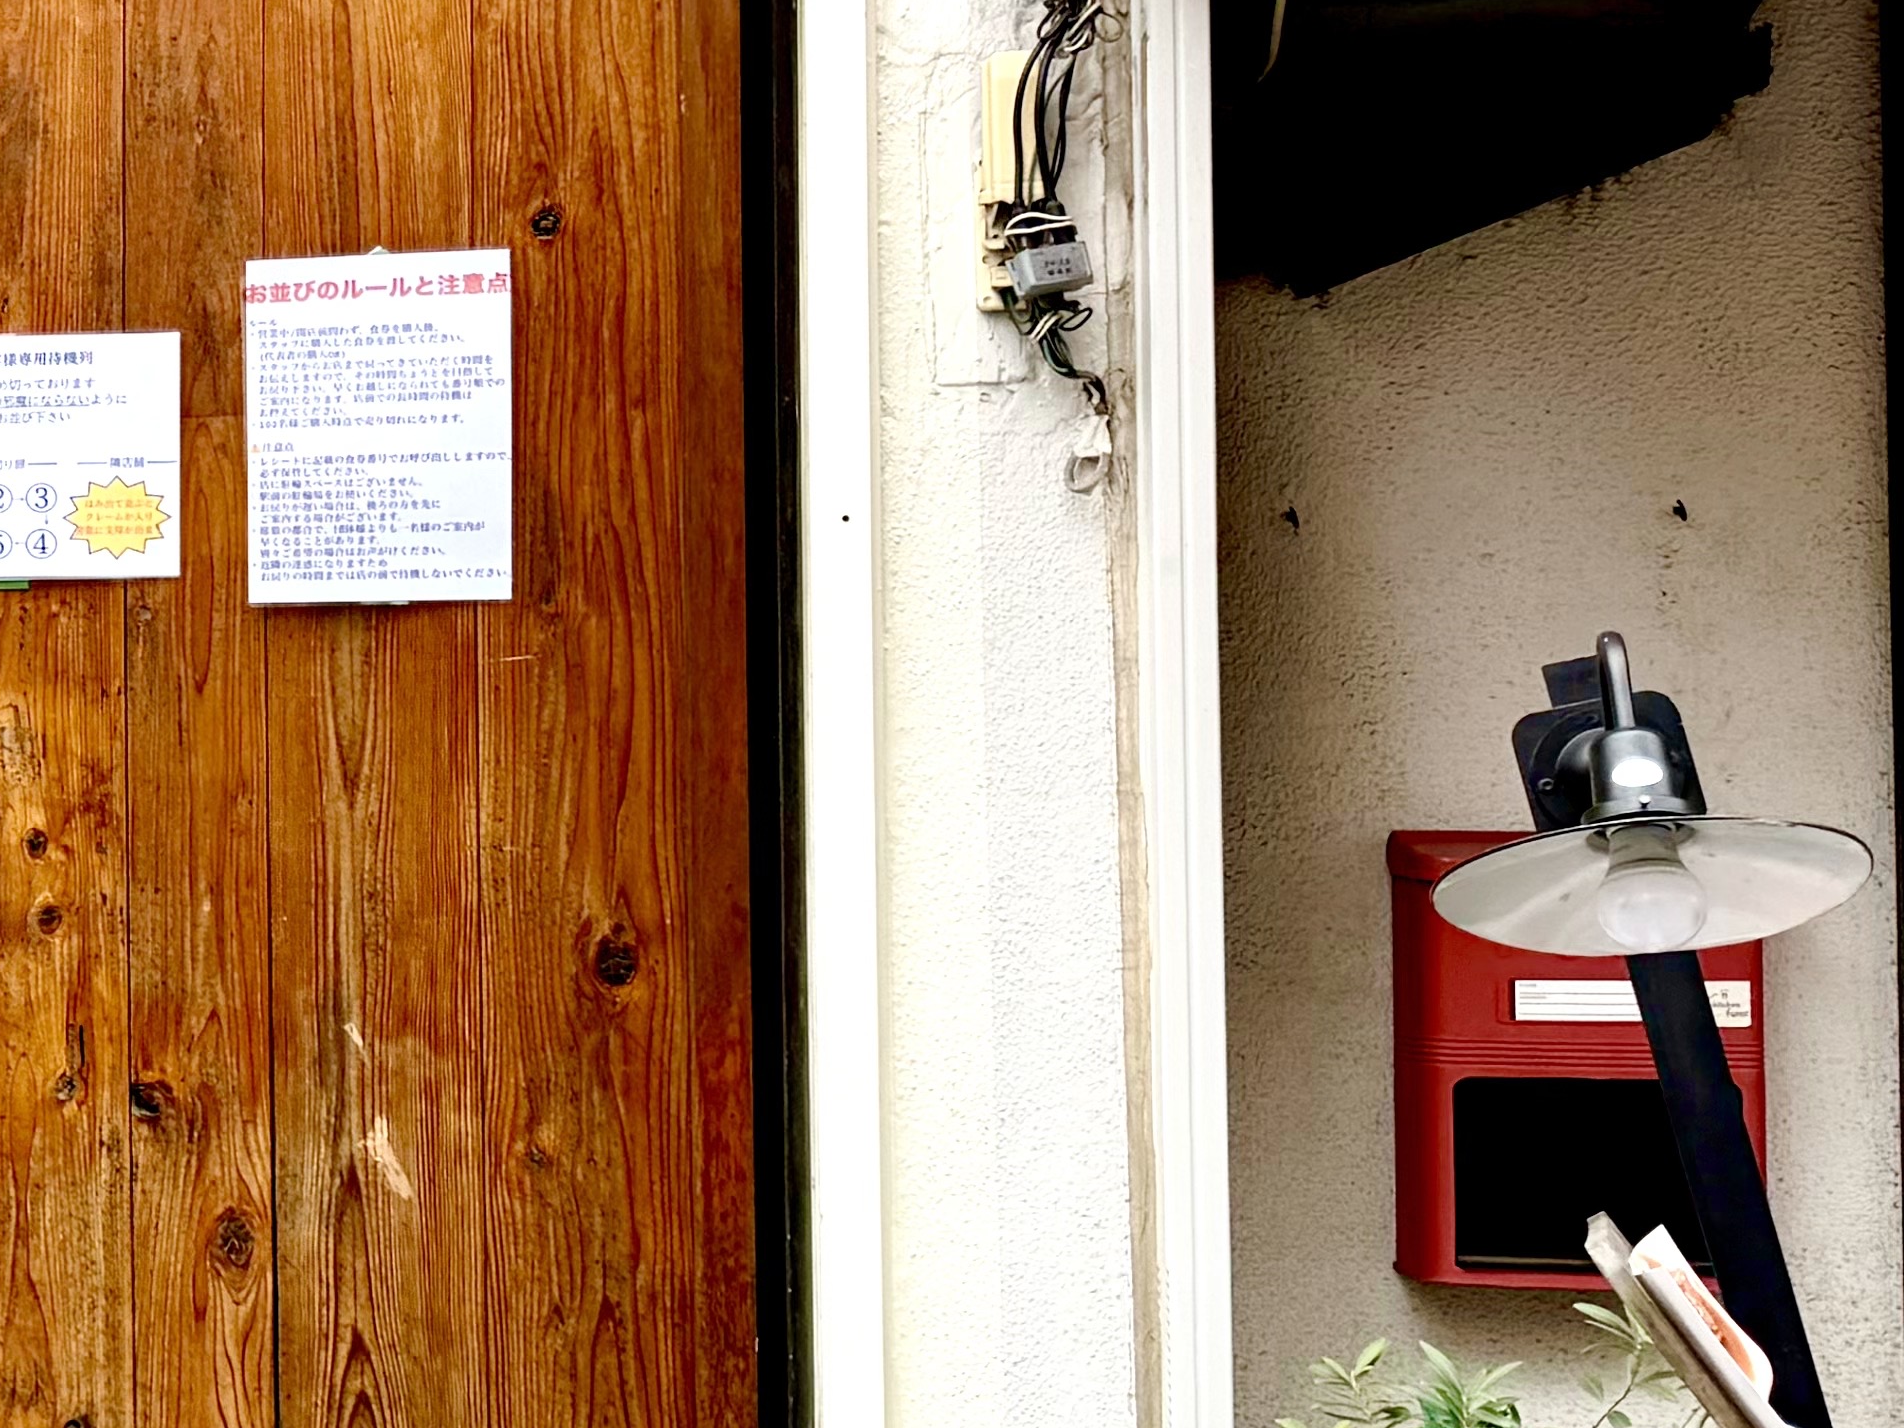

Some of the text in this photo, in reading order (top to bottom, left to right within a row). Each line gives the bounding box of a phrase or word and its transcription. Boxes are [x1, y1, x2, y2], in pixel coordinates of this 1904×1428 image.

[246, 273, 511, 304] お並びのルールと注意点
